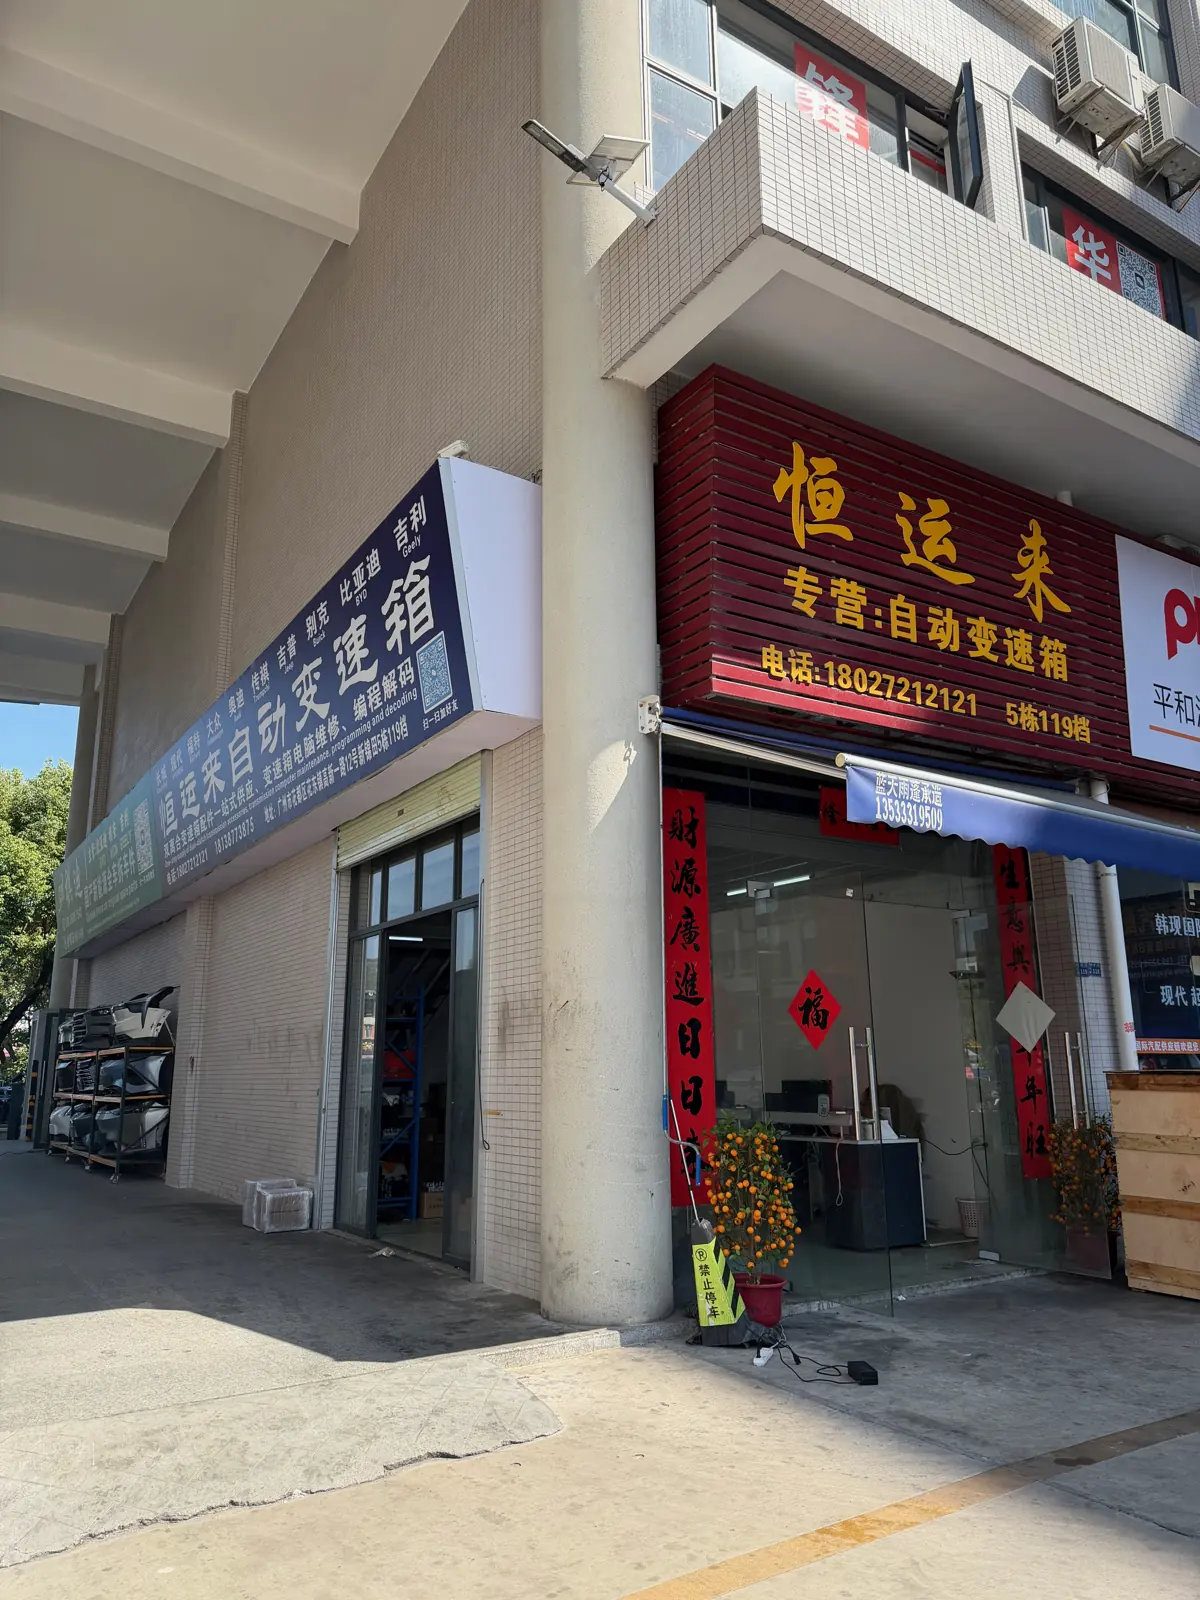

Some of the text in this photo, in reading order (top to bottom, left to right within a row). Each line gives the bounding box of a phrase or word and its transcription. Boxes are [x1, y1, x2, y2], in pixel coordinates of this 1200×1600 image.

[1071, 225, 1112, 282] 华
[393, 495, 427, 551] 吉利
[772, 441, 1072, 623] 恒运来
[402, 534, 421, 558] Geely
[339, 548, 381, 606] 比亚迪
[355, 588, 368, 606] BYD
[305, 600, 330, 641] 别克
[313, 629, 326, 648] Buick
[1164, 588, 1200, 660] p
[276, 633, 297, 670] 吉普
[158, 555, 434, 838] 恒运来自动变速箱
[251, 660, 270, 695] 传祺
[228, 688, 245, 718] 奥迪
[331, 722, 371, 755] programming
[371, 710, 384, 725] and
[384, 686, 418, 718] decoding
[422, 698, 459, 731] 扫一扫加好友
[1005, 701, 1092, 745] 5栋119档
[206, 711, 222, 738] 大众
[876, 795, 942, 831] 13533319509
[797, 985, 831, 1031] 福
[1160, 985, 1188, 1007] 现代
[698, 1263, 720, 1319] 禁止停车
